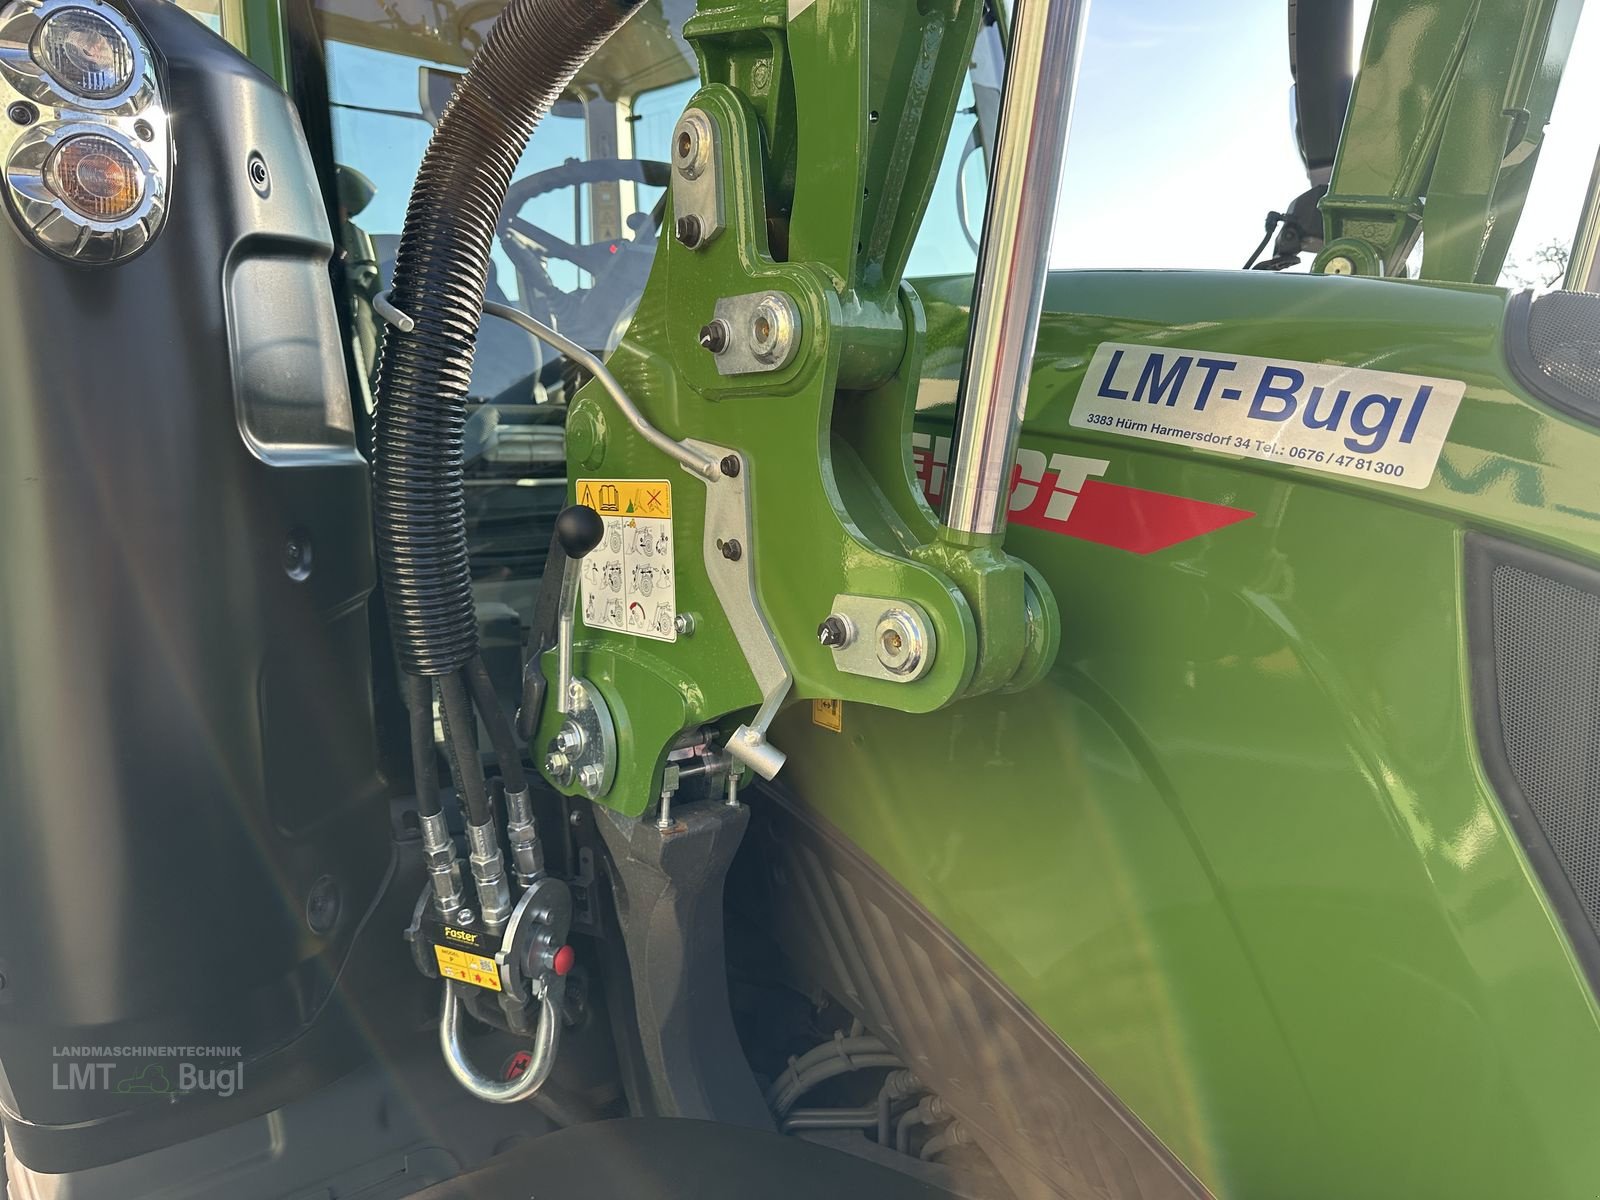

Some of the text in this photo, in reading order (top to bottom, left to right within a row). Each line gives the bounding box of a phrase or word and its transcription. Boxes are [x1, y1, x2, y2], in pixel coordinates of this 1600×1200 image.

[1087, 413, 1113, 426] 3383
[1115, 417, 1147, 432] Hürm
[1150, 423, 1232, 446] Harmersdorf
[1234, 437, 1250, 449] 34
[1255, 440, 1285, 455] Tel.:
[445, 926, 478, 943] Faster
